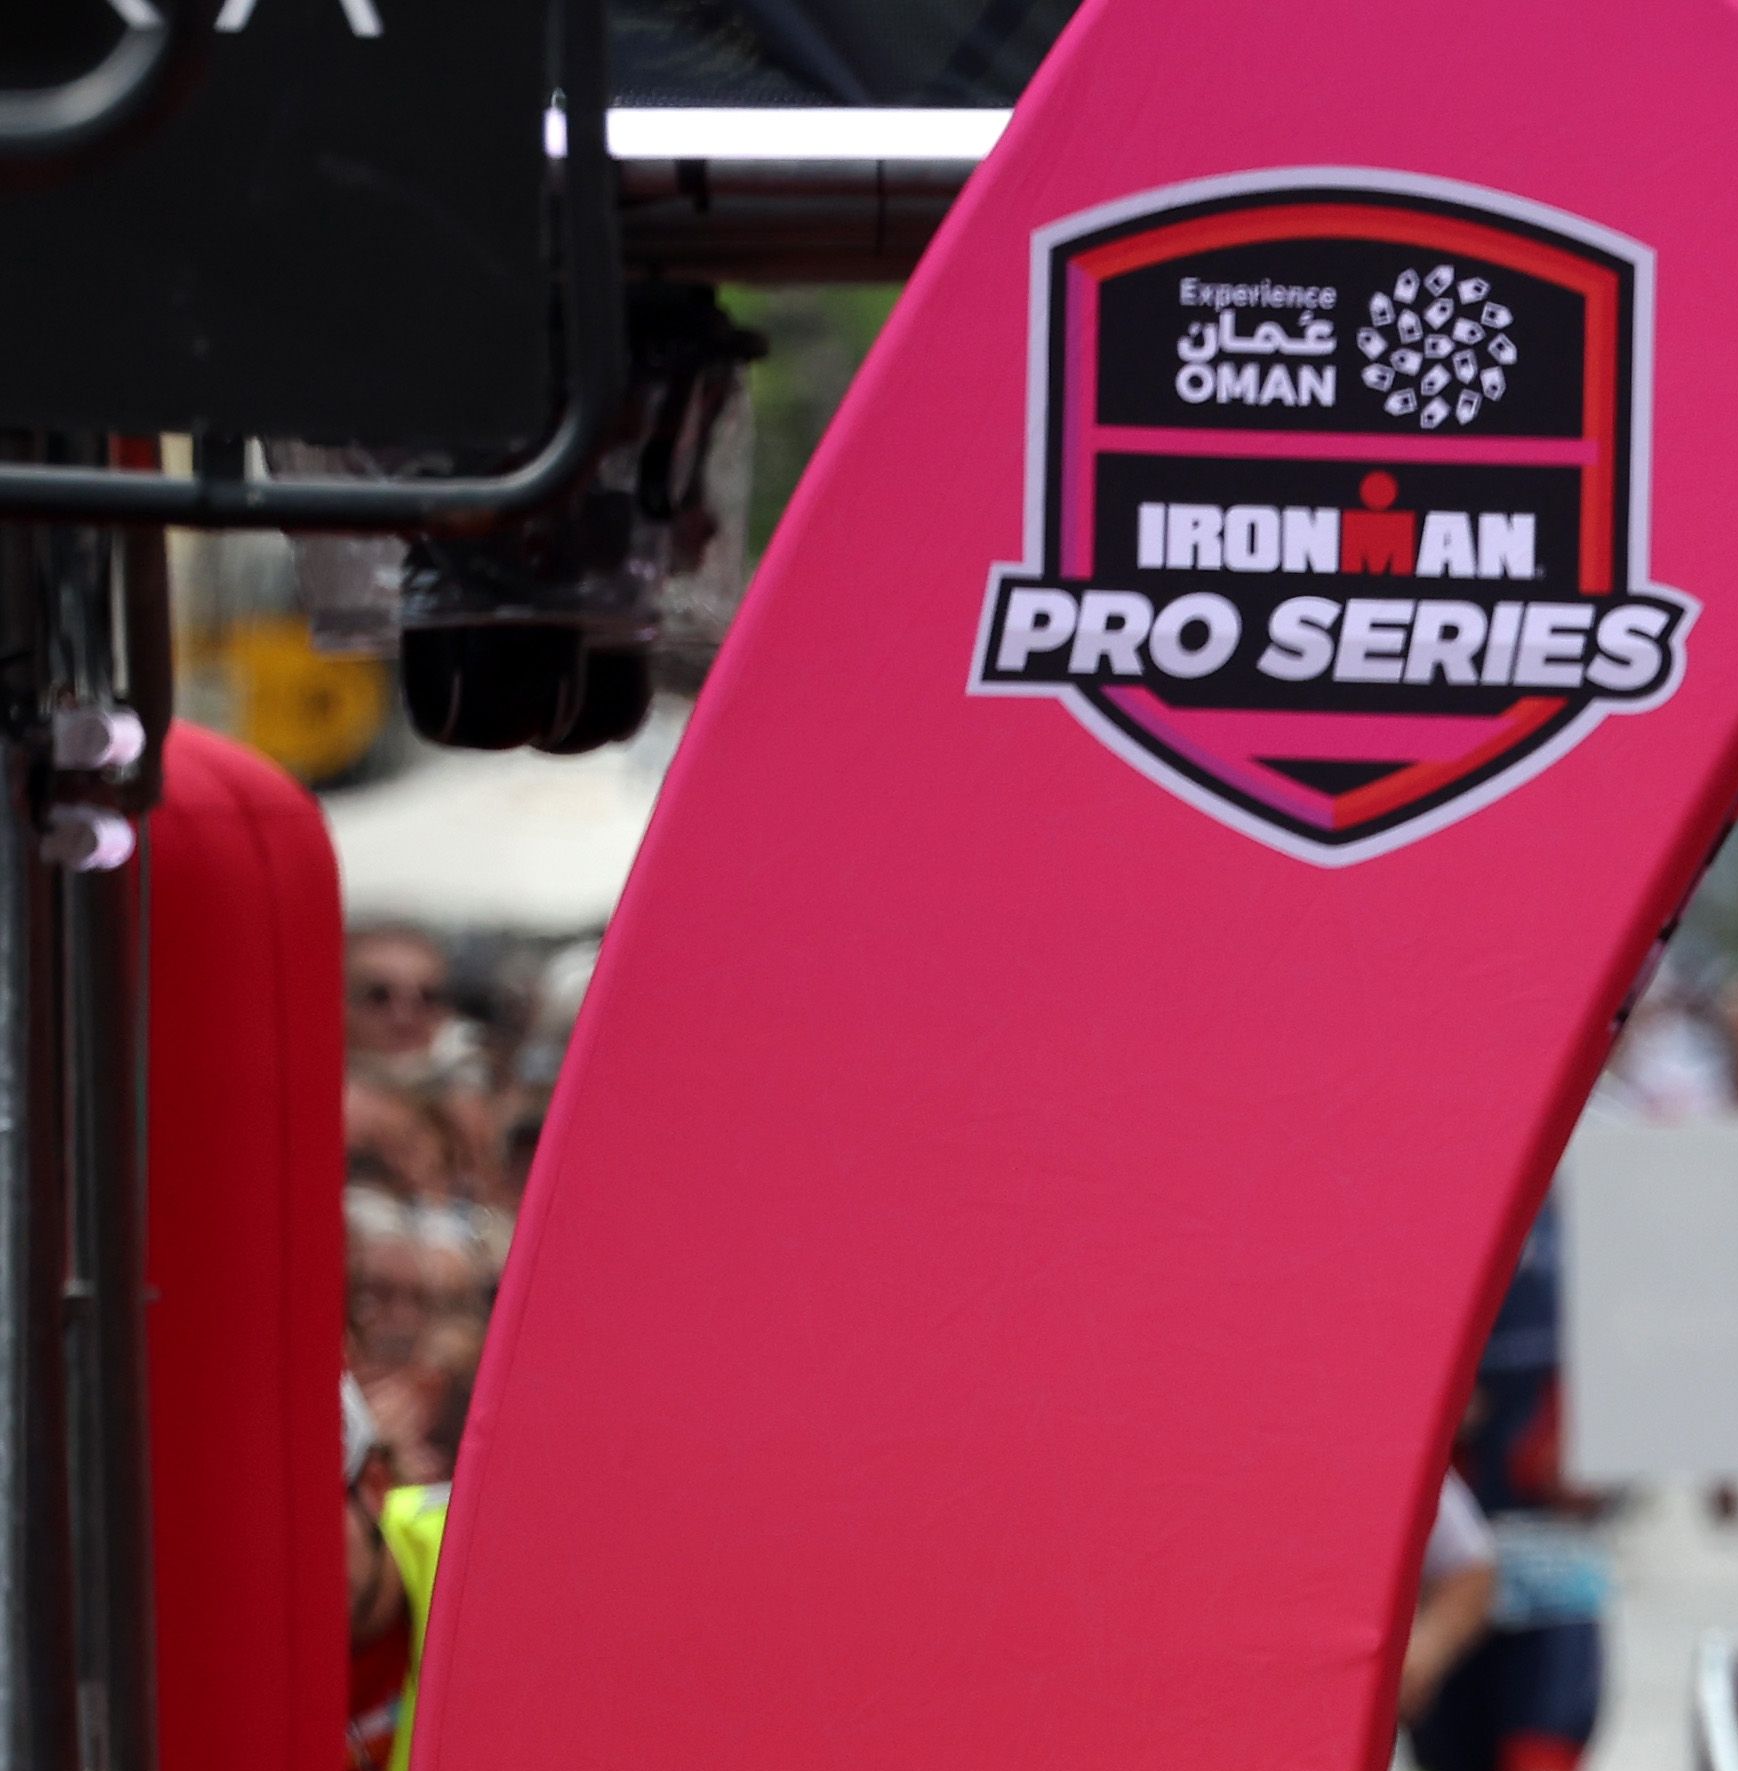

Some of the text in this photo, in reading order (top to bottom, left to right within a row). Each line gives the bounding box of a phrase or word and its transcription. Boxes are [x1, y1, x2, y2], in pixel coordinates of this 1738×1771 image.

[1179, 276, 1337, 313] Experience
[1175, 361, 1337, 407] OMAN
[1137, 502, 1537, 579] IRONMAN
[997, 587, 1671, 691] PRO SERIES
